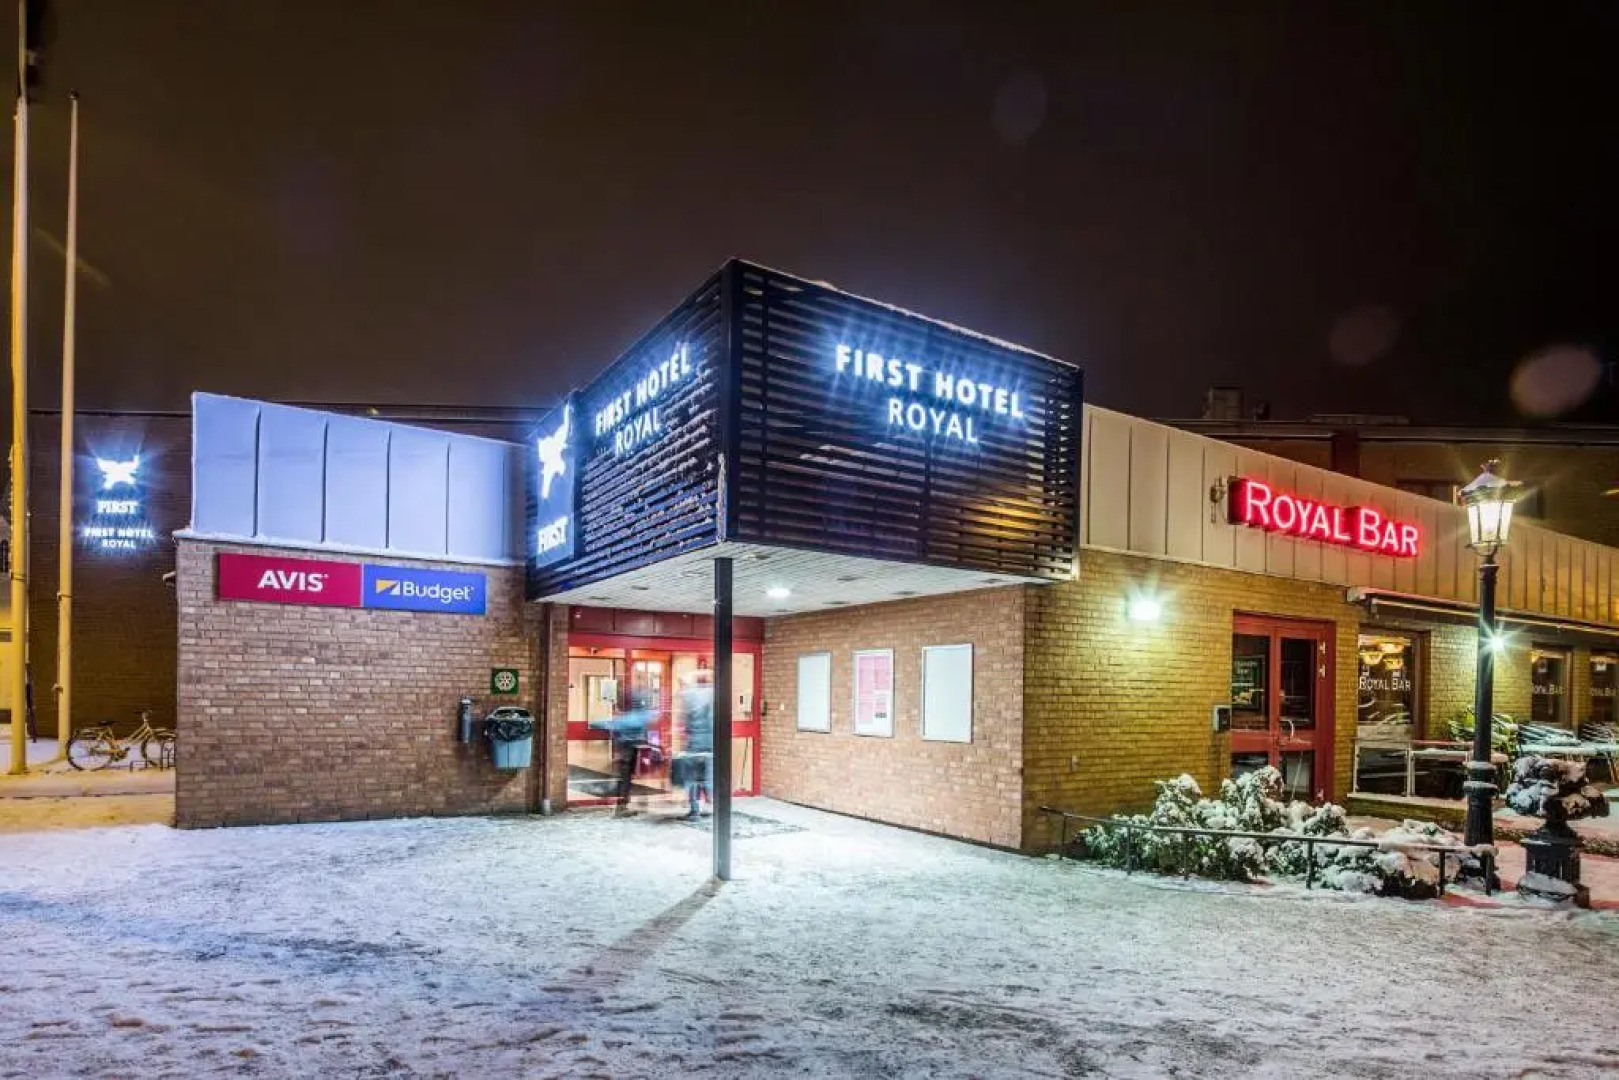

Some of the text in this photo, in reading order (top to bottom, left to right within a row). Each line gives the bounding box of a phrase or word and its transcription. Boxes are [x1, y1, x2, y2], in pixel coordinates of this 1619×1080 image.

[595, 342, 691, 437] FIRST HOTEL
[835, 343, 1024, 418] FIRST HOTEL
[615, 407, 660, 458] ROYAL
[889, 398, 978, 443] ROYAL
[97, 500, 139, 513] FIRST
[1245, 481, 1418, 555] ROYAL BAR
[84, 527, 153, 538] FIRST HOTEL
[102, 539, 136, 549] ROYAL
[538, 516, 568, 553] FIRST
[257, 570, 323, 592] AVIS
[402, 581, 470, 604] Budget
